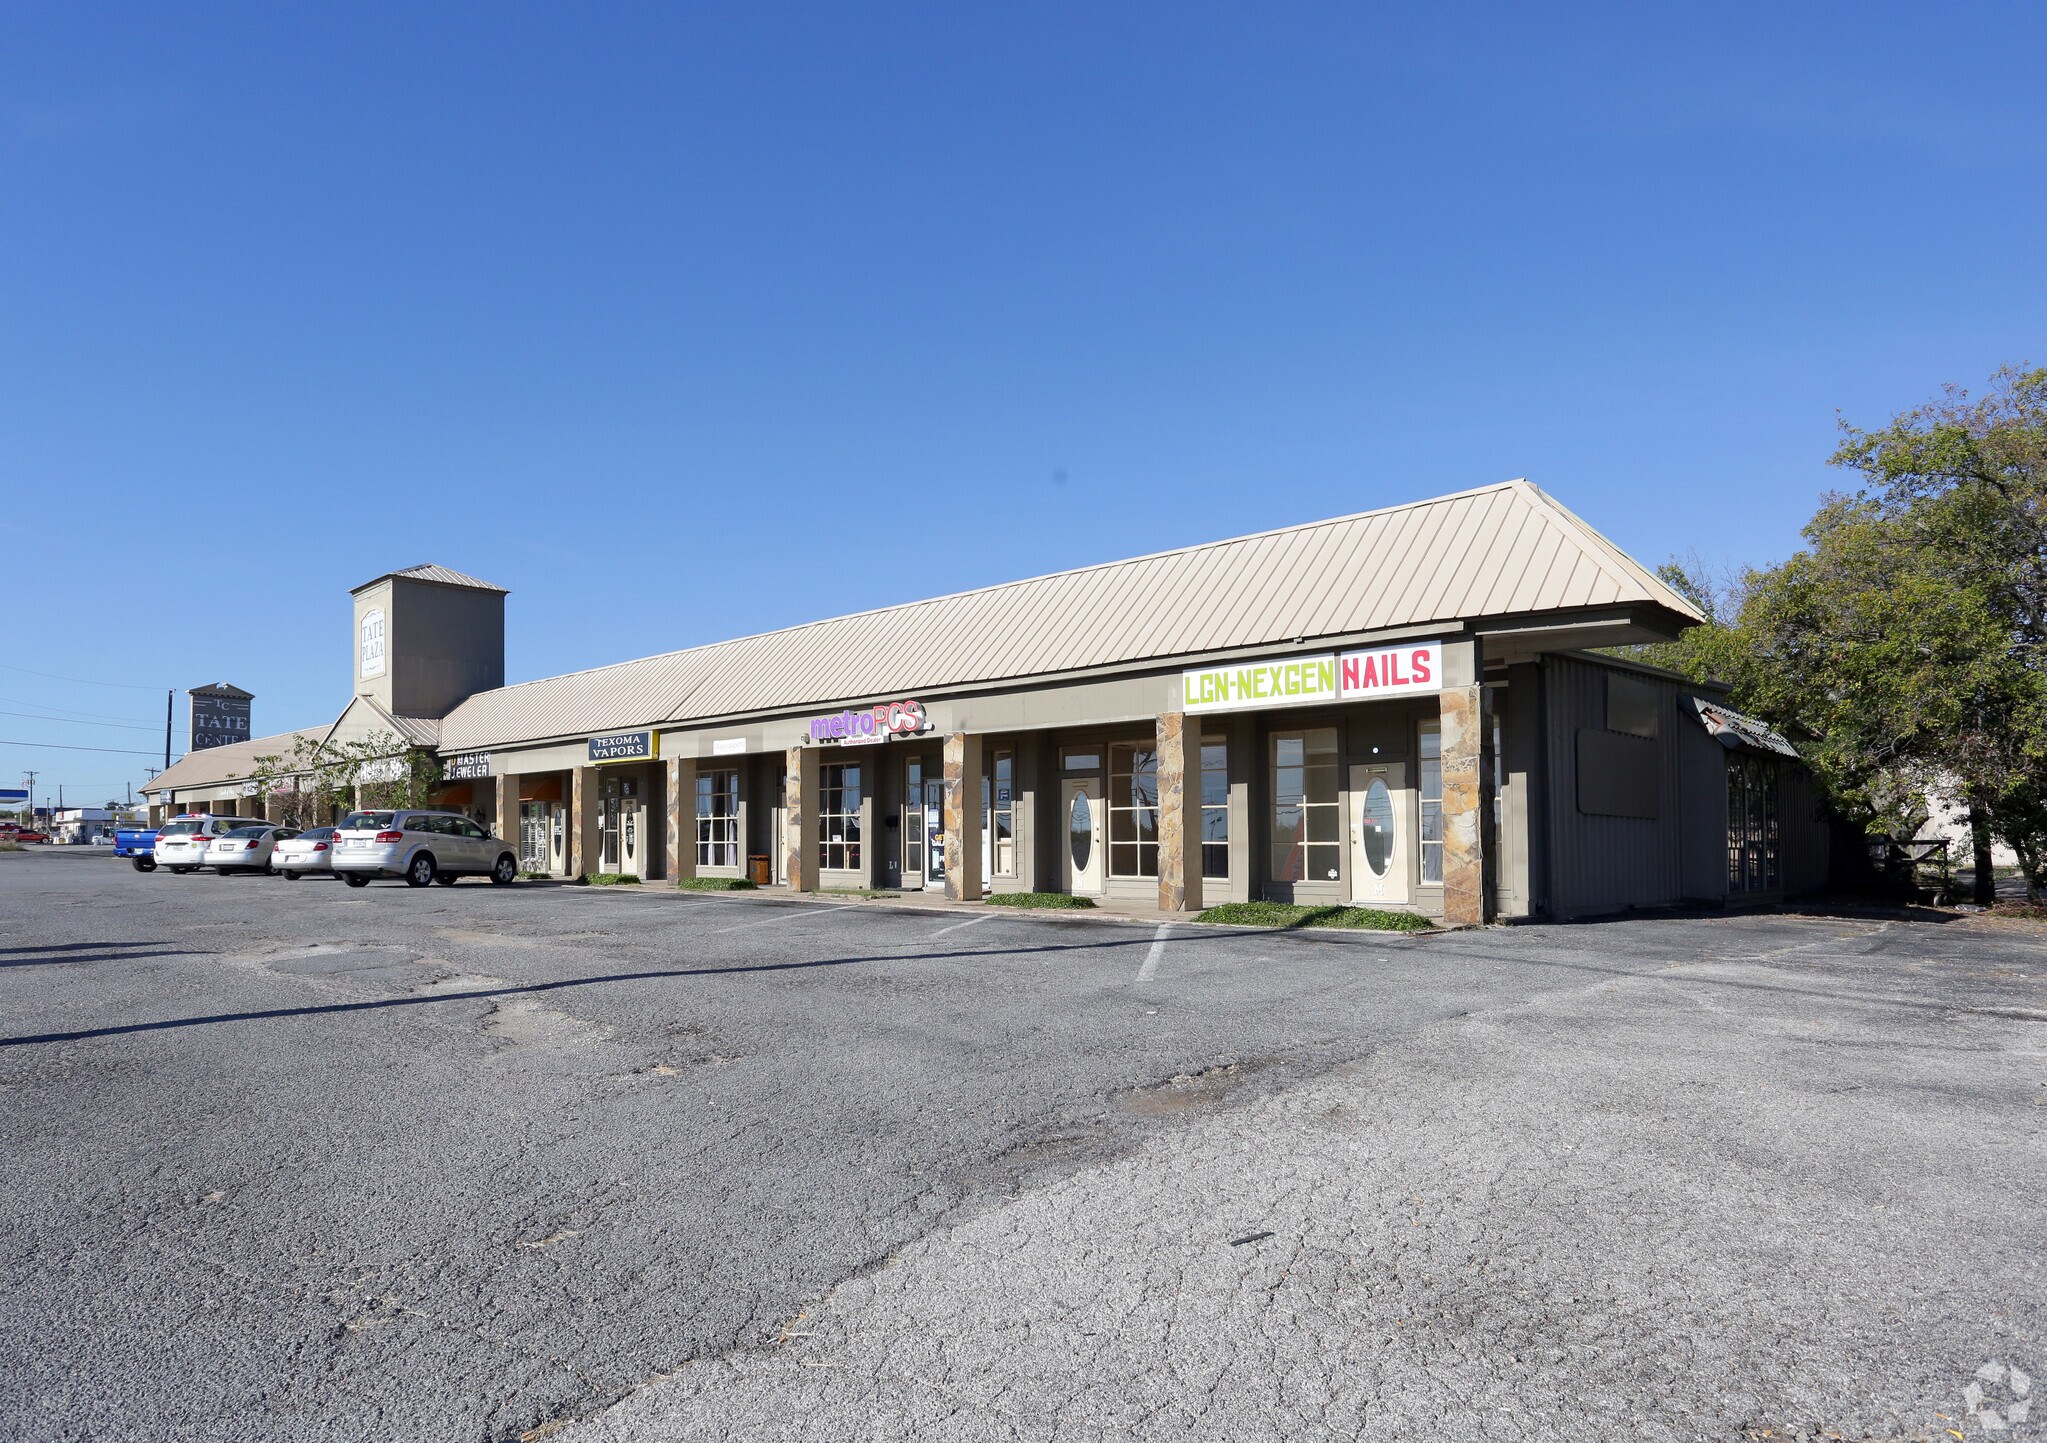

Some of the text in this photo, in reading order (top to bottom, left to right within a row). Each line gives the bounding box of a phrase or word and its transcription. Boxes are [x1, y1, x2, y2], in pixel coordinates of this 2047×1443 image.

[362, 620, 384, 642] TATE
[362, 641, 384, 662] PLAZA
[1185, 649, 1431, 705] LGN-NEXGEN NAILS
[195, 713, 248, 730] TATE
[810, 700, 919, 740] metroPCS
[594, 735, 640, 747] TEXOMA
[456, 751, 490, 765] MASTER
[593, 744, 643, 758] VAPORS
[451, 764, 487, 779] JEWELER
